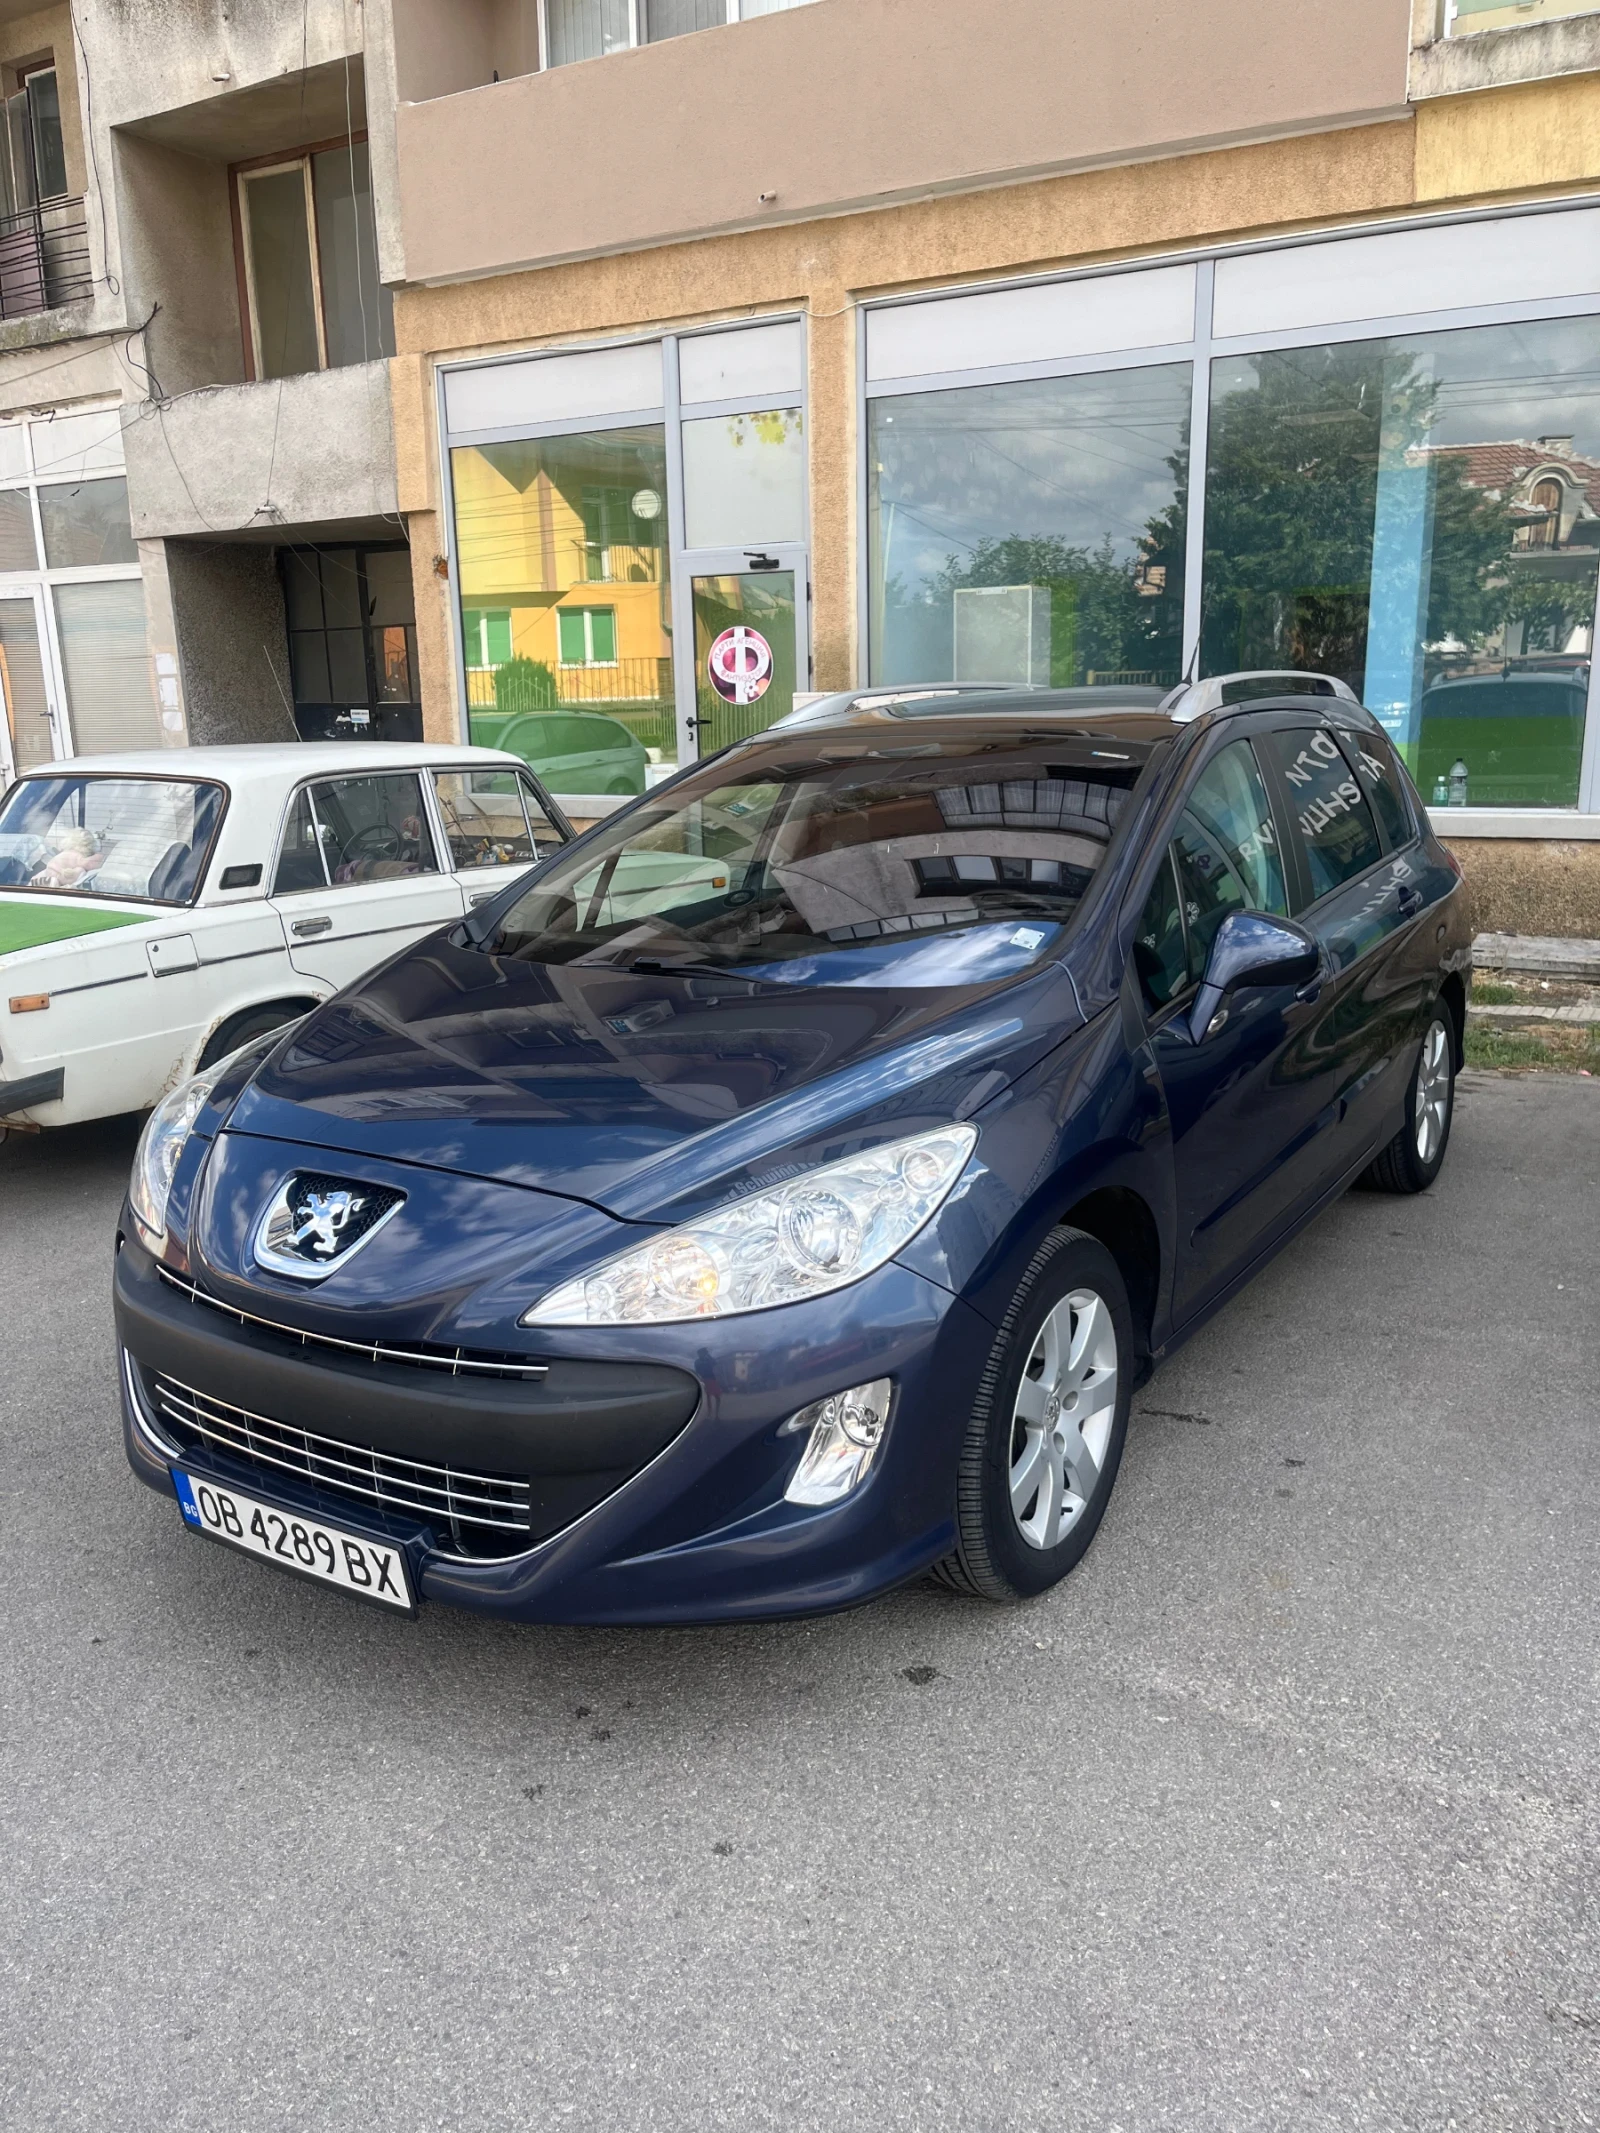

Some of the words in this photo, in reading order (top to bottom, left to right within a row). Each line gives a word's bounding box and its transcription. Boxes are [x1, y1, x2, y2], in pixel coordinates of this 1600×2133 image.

[715, 639, 735, 660] ПАРТИ
[737, 637, 766, 659] АГЕНЦИЯ
[183, 1501, 198, 1517] BG
[250, 1507, 335, 1574] 4289
[341, 1538, 401, 1598] BX
